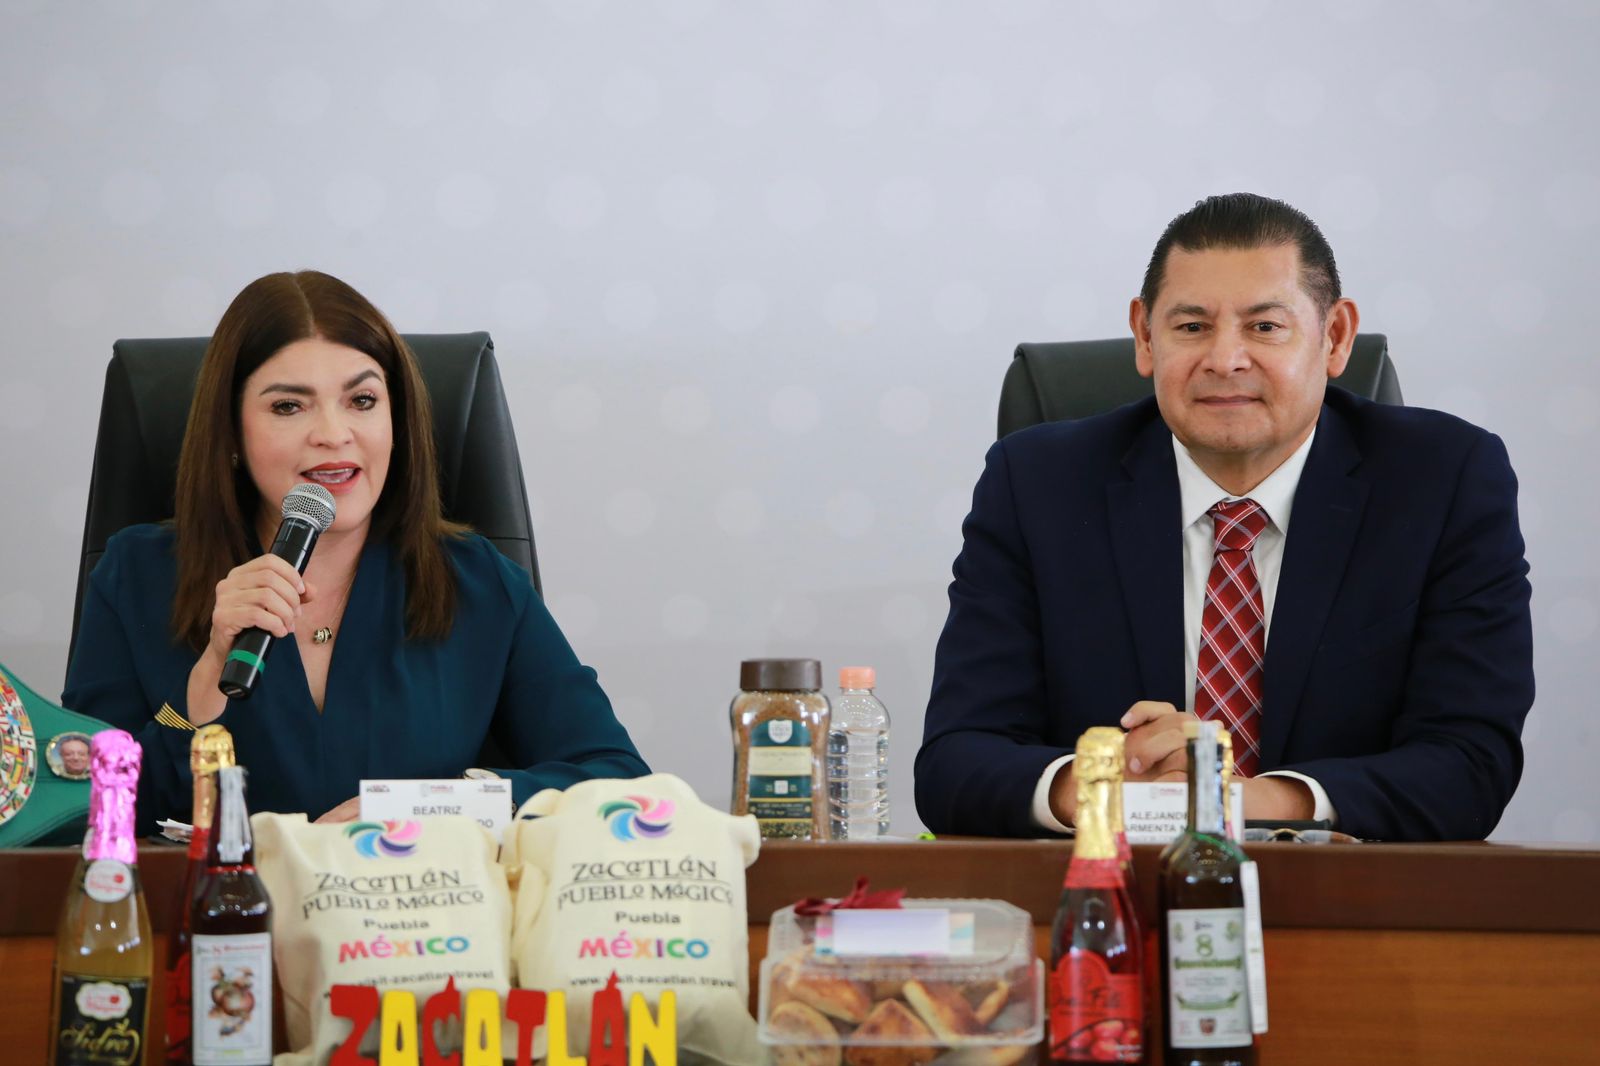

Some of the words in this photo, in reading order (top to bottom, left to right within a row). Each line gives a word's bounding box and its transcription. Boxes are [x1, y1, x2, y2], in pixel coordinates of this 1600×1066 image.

[413, 805, 462, 816] BEATRIZ
[363, 918, 430, 930] Puebla
[614, 911, 681, 924] Puebla
[1196, 934, 1213, 957] 8
[330, 970, 678, 1066] ZACATLÁN
